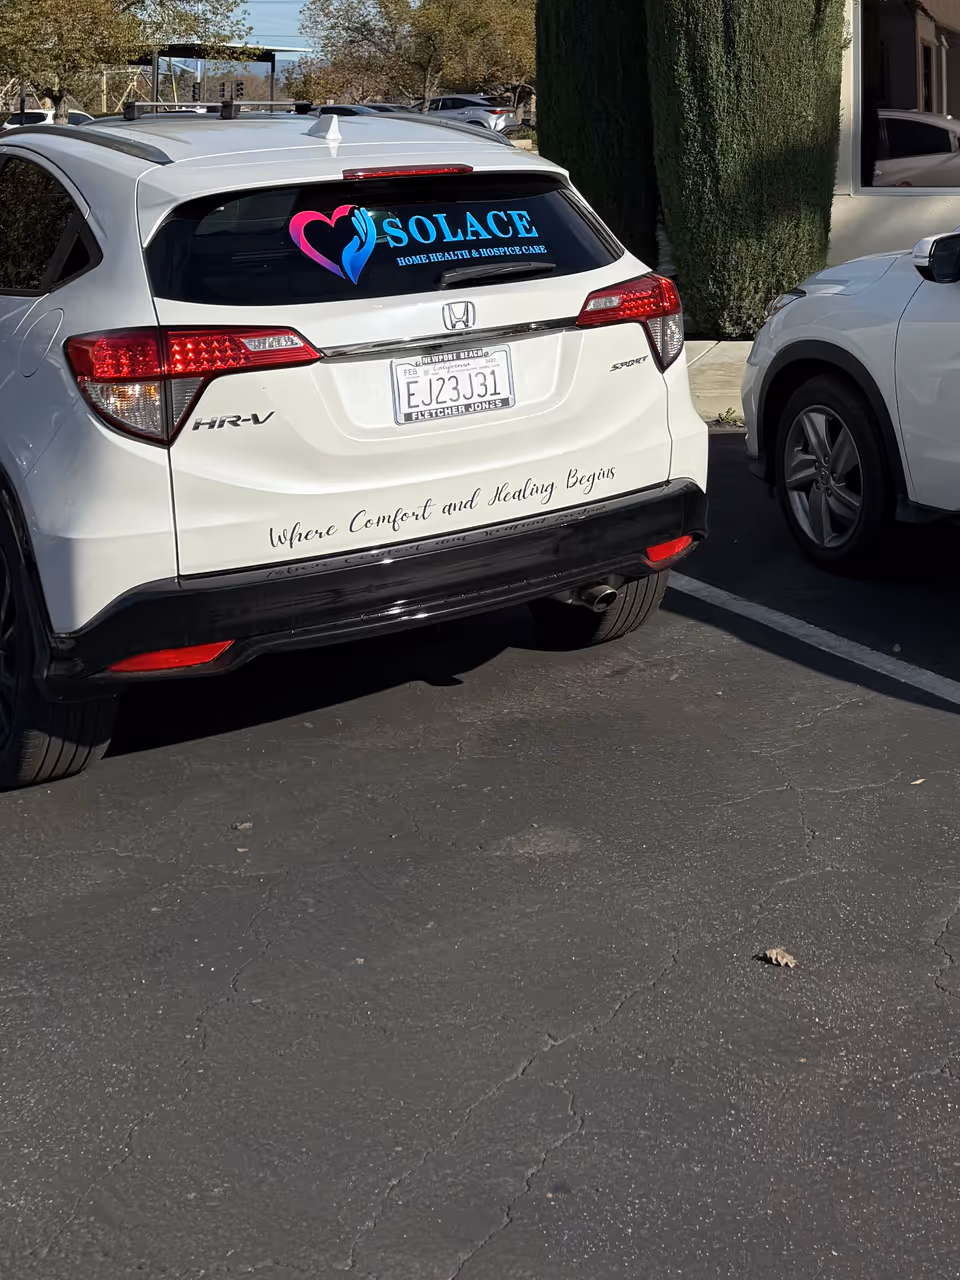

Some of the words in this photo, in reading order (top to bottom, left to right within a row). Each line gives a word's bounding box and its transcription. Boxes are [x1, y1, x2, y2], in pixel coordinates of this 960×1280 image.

[382, 210, 539, 248] SOLACE
[397, 254, 429, 267] HOME
[429, 250, 471, 262] HEALTH
[471, 248, 480, 258] &
[481, 246, 522, 258] HOSPICE
[522, 245, 547, 255] CARE
[422, 352, 457, 364] NEWPORT
[460, 349, 483, 359] BEACH
[609, 355, 648, 372] SPORT
[403, 368, 418, 376] FEB
[406, 370, 501, 409] EJ23J31
[192, 410, 276, 431] HR-V
[412, 406, 466, 420] FLETCHER
[468, 400, 502, 412] JONES
[269, 523, 338, 549] Where
[349, 498, 433, 536] Comfort
[443, 488, 482, 517] and
[488, 478, 558, 507] Healing
[566, 465, 617, 494] Begins
